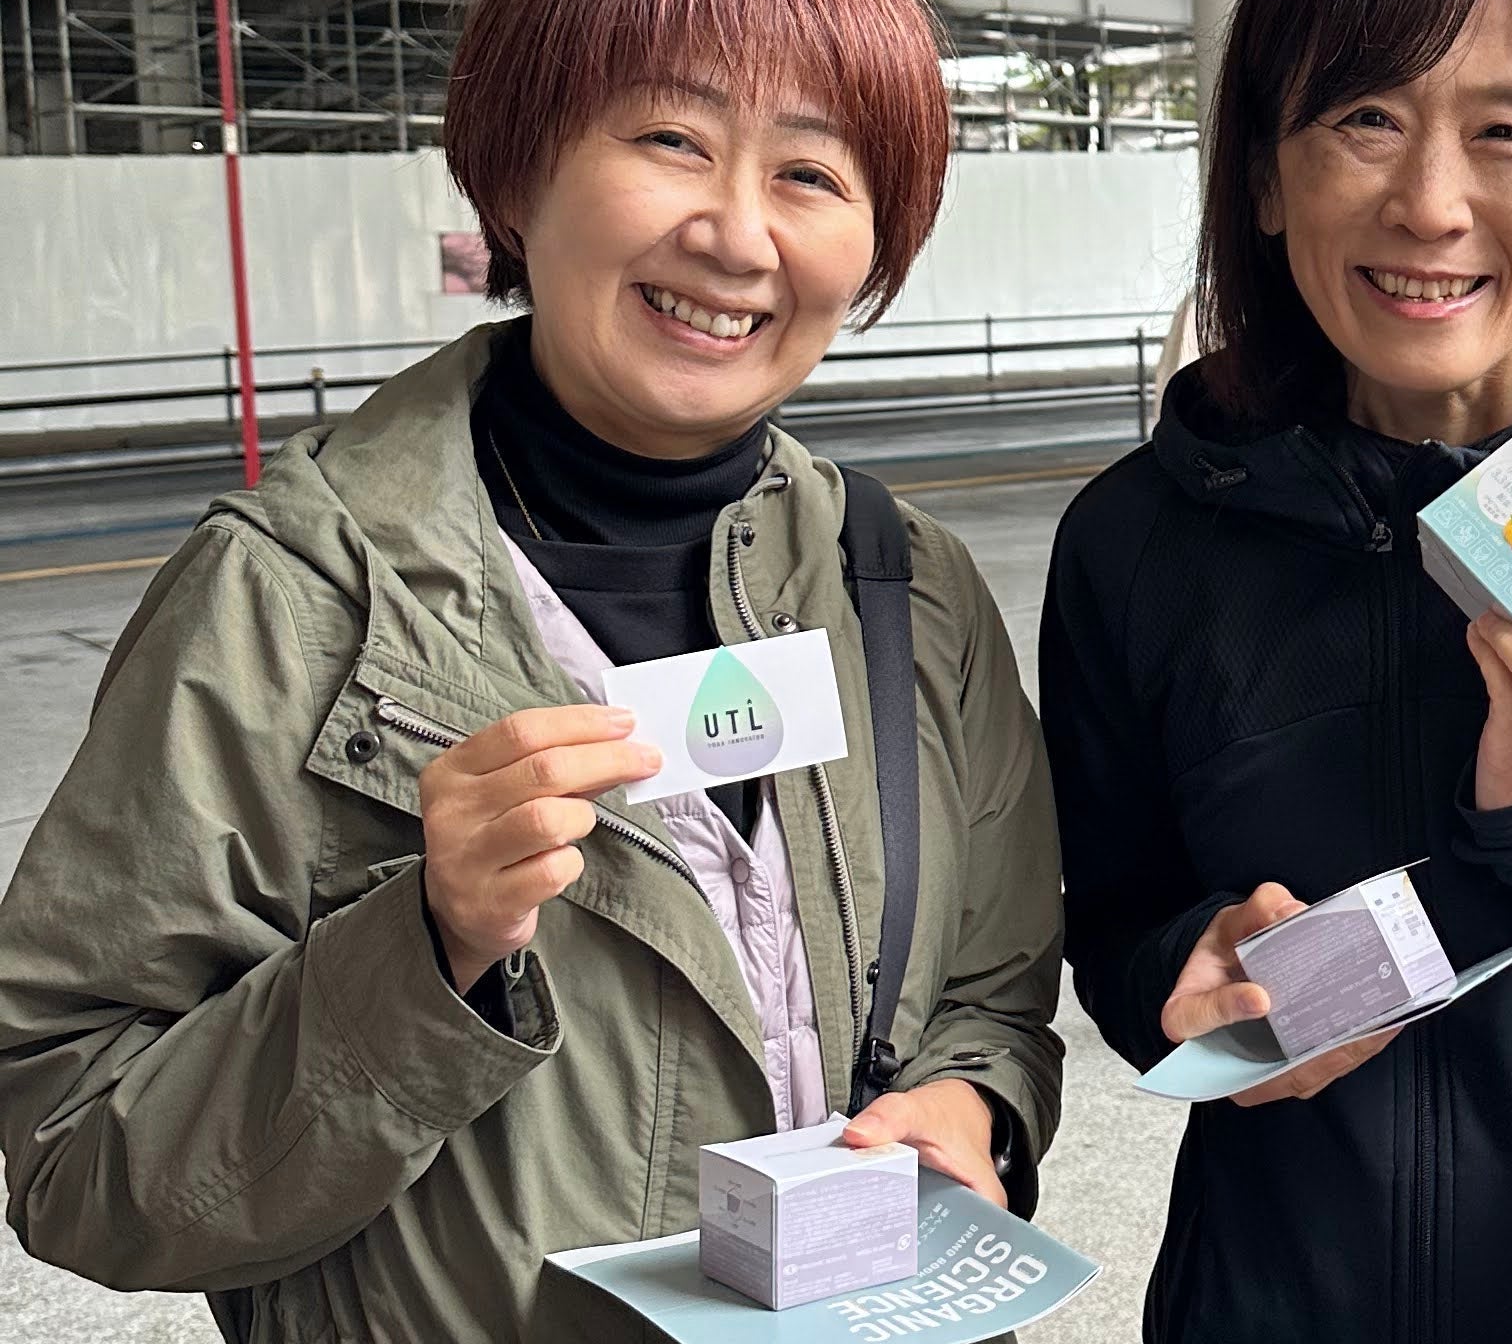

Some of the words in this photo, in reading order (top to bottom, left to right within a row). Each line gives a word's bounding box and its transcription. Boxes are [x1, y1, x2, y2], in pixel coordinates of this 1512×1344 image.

[917, 1258, 947, 1278] BOOK
[945, 1224, 979, 1257] BRAND
[828, 1233, 1012, 1321] SCIENCE
[849, 1254, 1048, 1342] ORGANIC
